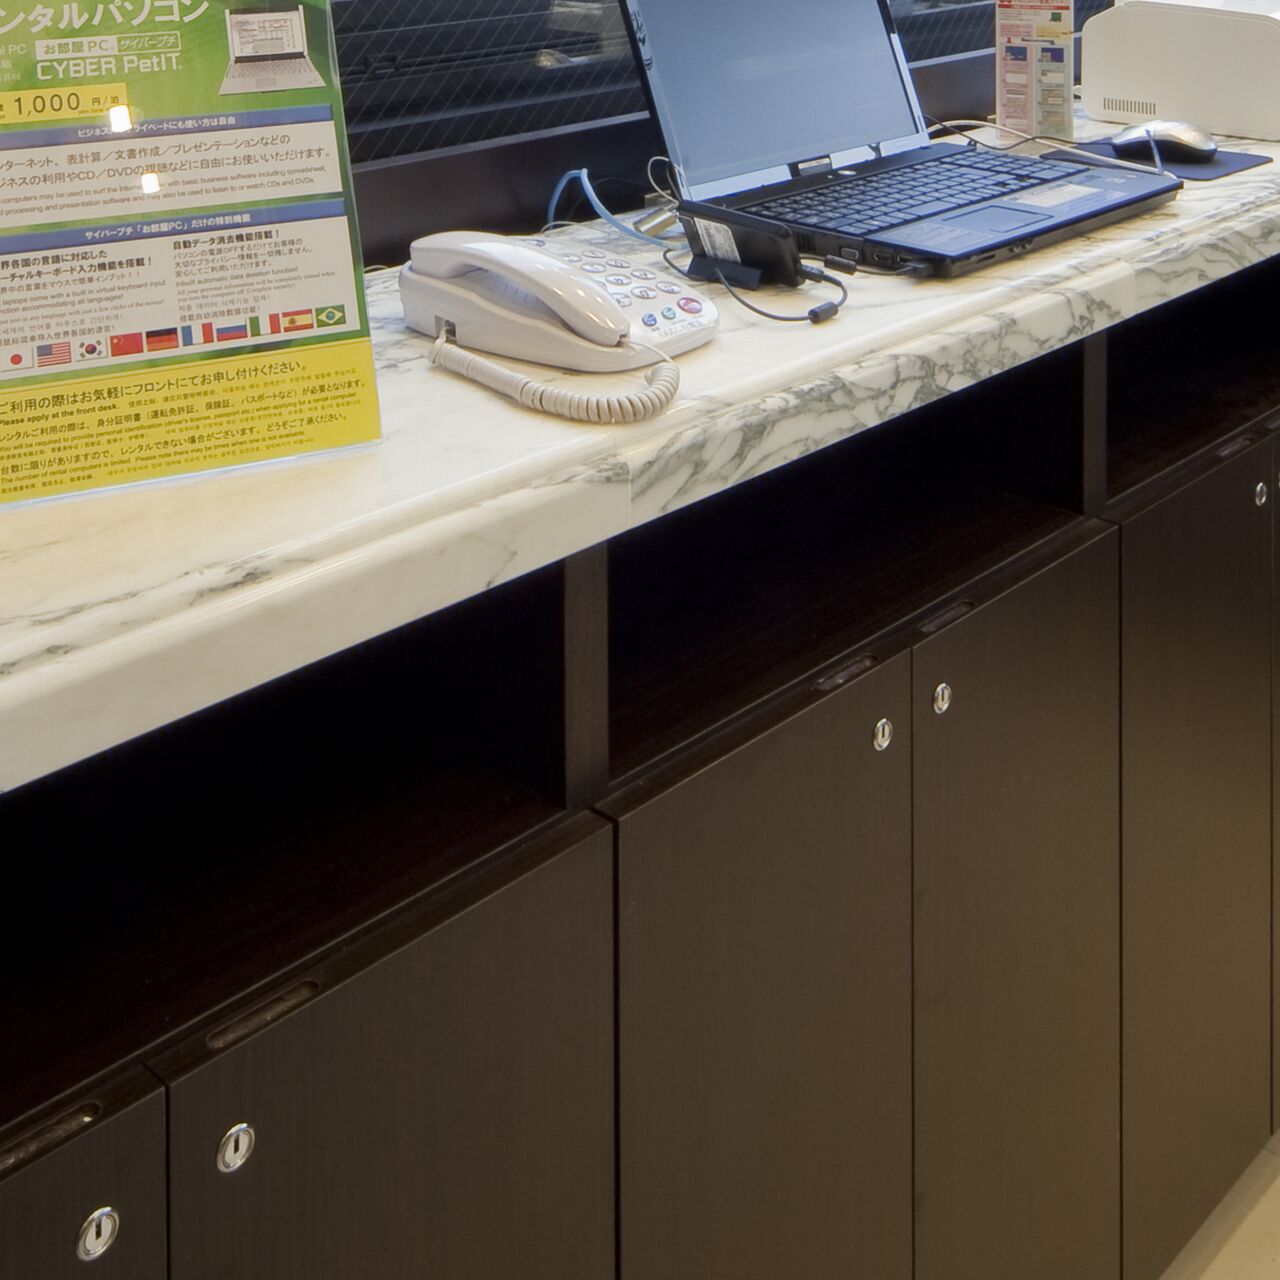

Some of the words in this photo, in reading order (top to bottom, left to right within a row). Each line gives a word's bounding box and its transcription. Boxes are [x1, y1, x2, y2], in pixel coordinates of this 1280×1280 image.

[8, 43, 27, 55] PC
[36, 57, 117, 81] CYBER
[14, 91, 81, 117] 1,000
[77, 115, 236, 139] ビジネスライベートにも使い方は自由
[118, 182, 145, 193] Interne
[26, 411, 49, 423] apply
[50, 410, 60, 420] at
[60, 408, 75, 418] the
[75, 405, 96, 416] front
[97, 401, 120, 413] desk.
